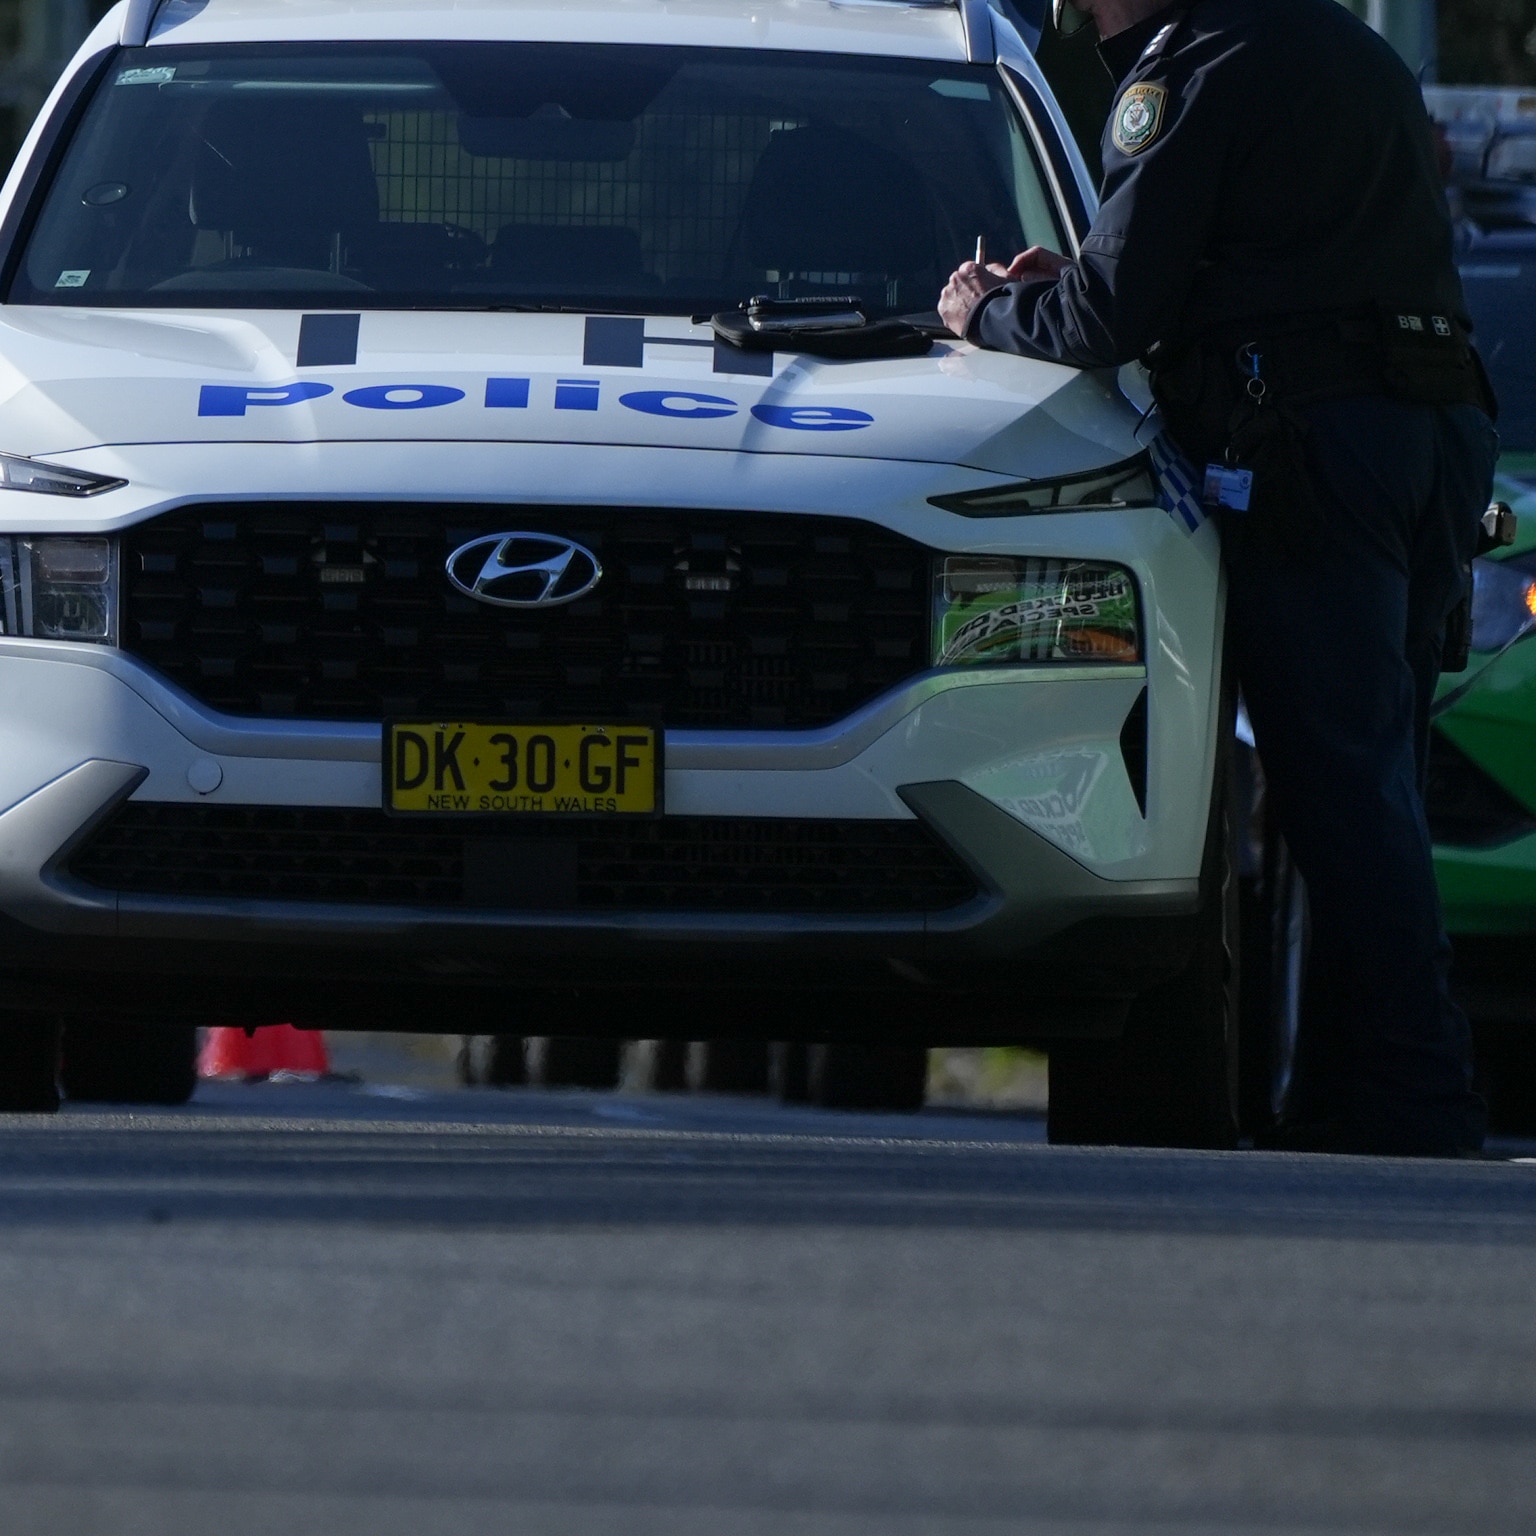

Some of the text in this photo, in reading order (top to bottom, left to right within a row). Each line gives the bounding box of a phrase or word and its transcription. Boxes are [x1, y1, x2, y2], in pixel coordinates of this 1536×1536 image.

[428, 795, 617, 812] NEW SOUTH WALES
